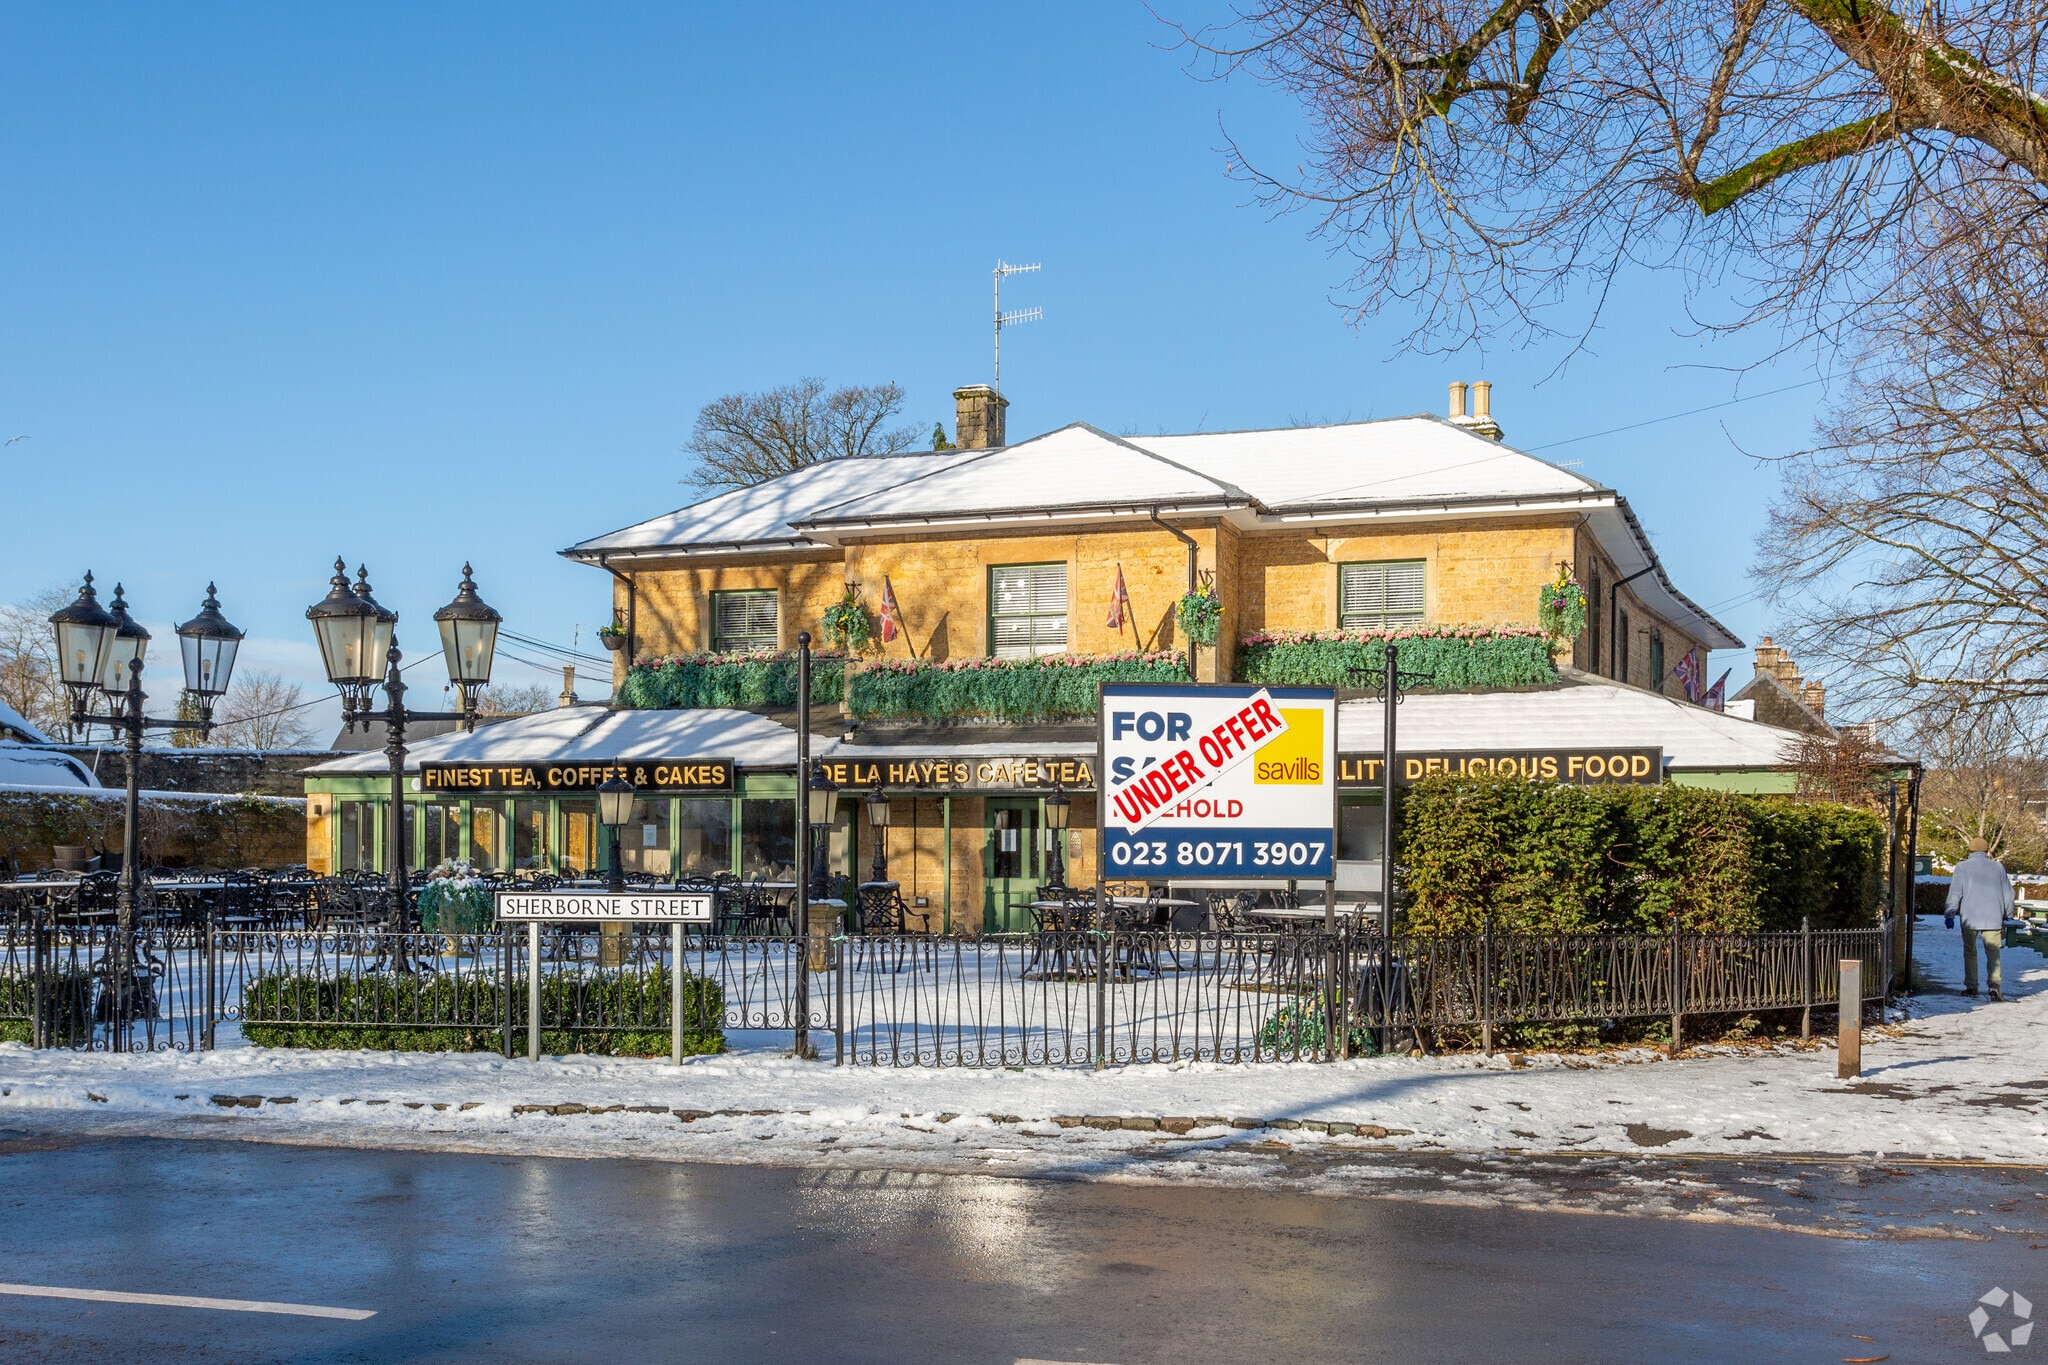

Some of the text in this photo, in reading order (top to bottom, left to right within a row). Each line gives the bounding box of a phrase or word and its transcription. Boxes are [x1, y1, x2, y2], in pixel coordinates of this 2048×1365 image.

[1112, 711, 1193, 742] FOR
[854, 764, 881, 783] LA
[889, 763, 969, 784] HAYE'S
[976, 762, 1039, 783] CAFE
[1046, 761, 1093, 783] TEA
[1113, 750, 1206, 823] UNDER
[1198, 698, 1282, 768] OFFER
[1257, 757, 1321, 781] savills
[1568, 755, 1651, 778] FOOD
[425, 768, 493, 787] FINEST
[498, 767, 542, 789] TEA,
[634, 766, 648, 785] &
[654, 765, 727, 785] CAKES
[1112, 841, 1326, 866] 023 8071 3907
[506, 899, 704, 916] SHERBORNE STREET
